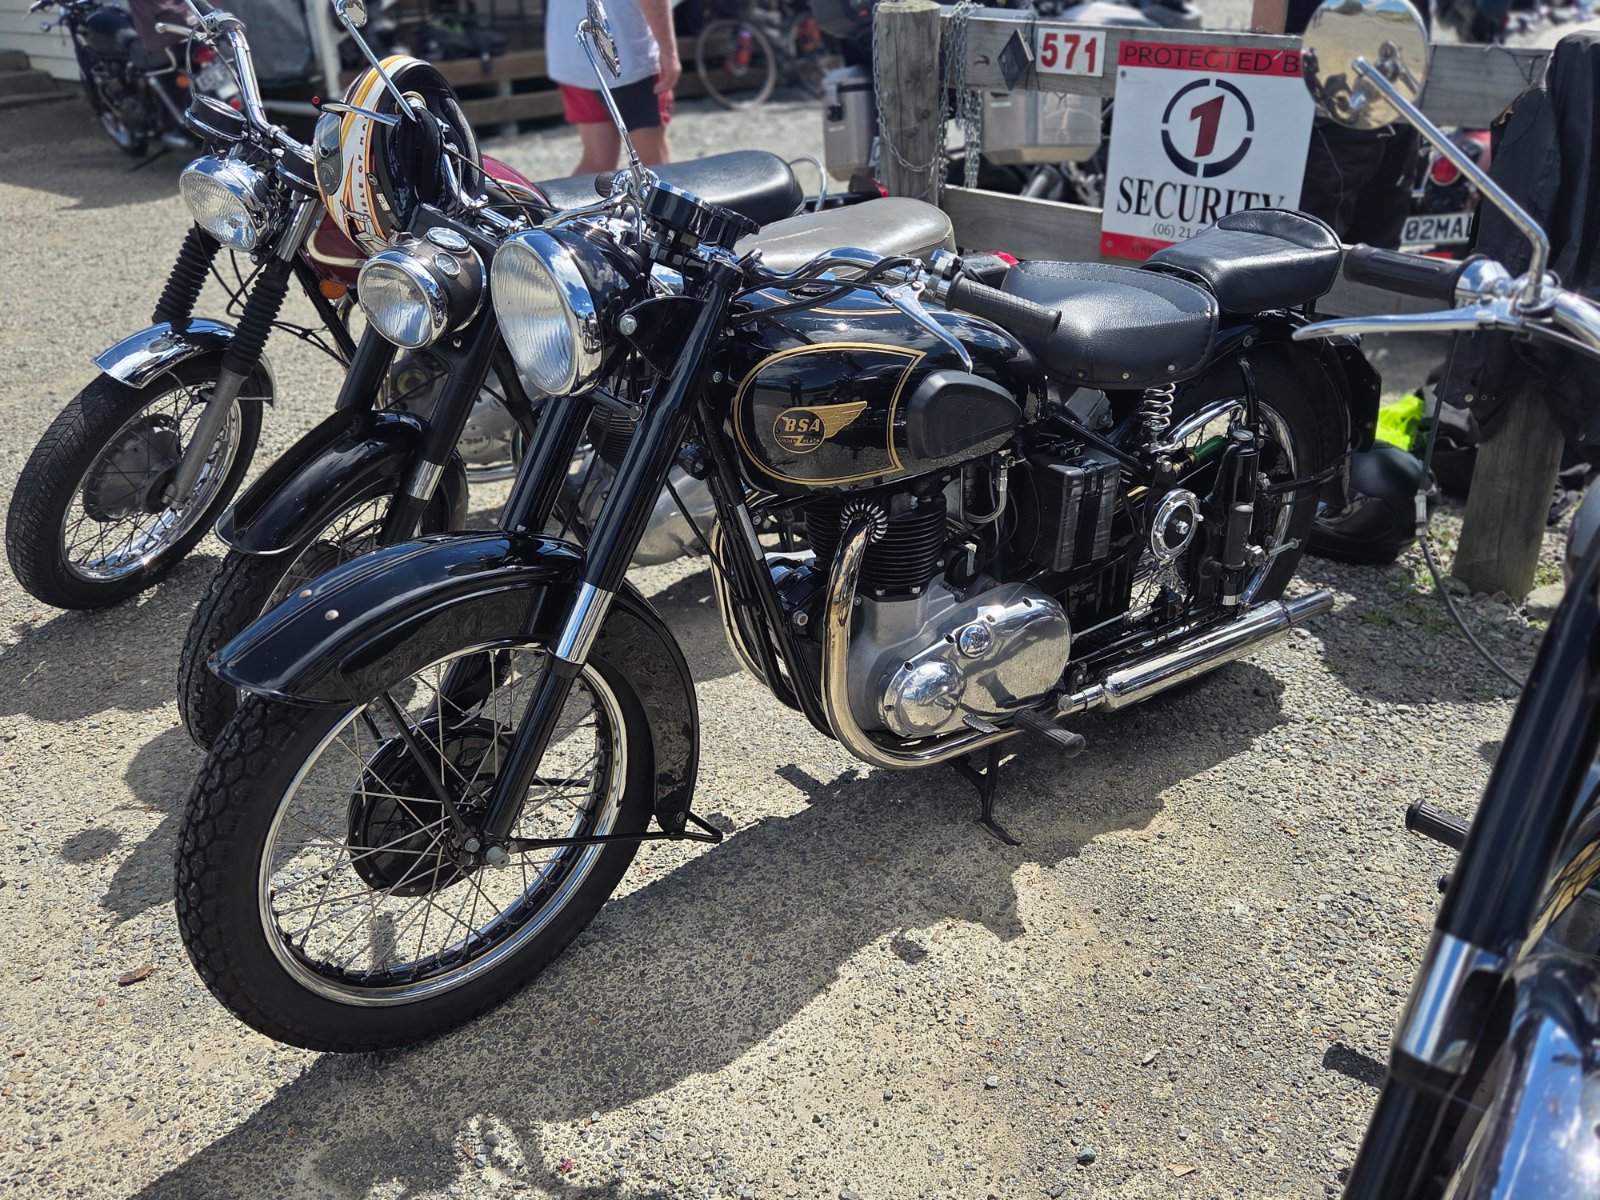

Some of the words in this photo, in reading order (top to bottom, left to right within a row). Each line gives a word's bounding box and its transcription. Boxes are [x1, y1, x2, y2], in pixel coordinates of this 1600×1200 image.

[1041, 32, 1097, 73] 571
[1124, 45, 1273, 72] PROTECTED
[1283, 54, 1300, 74] B
[360, 116, 368, 145] MA
[1190, 95, 1225, 157] 1
[1152, 222, 1176, 239] (06)
[781, 416, 821, 432] BSA
